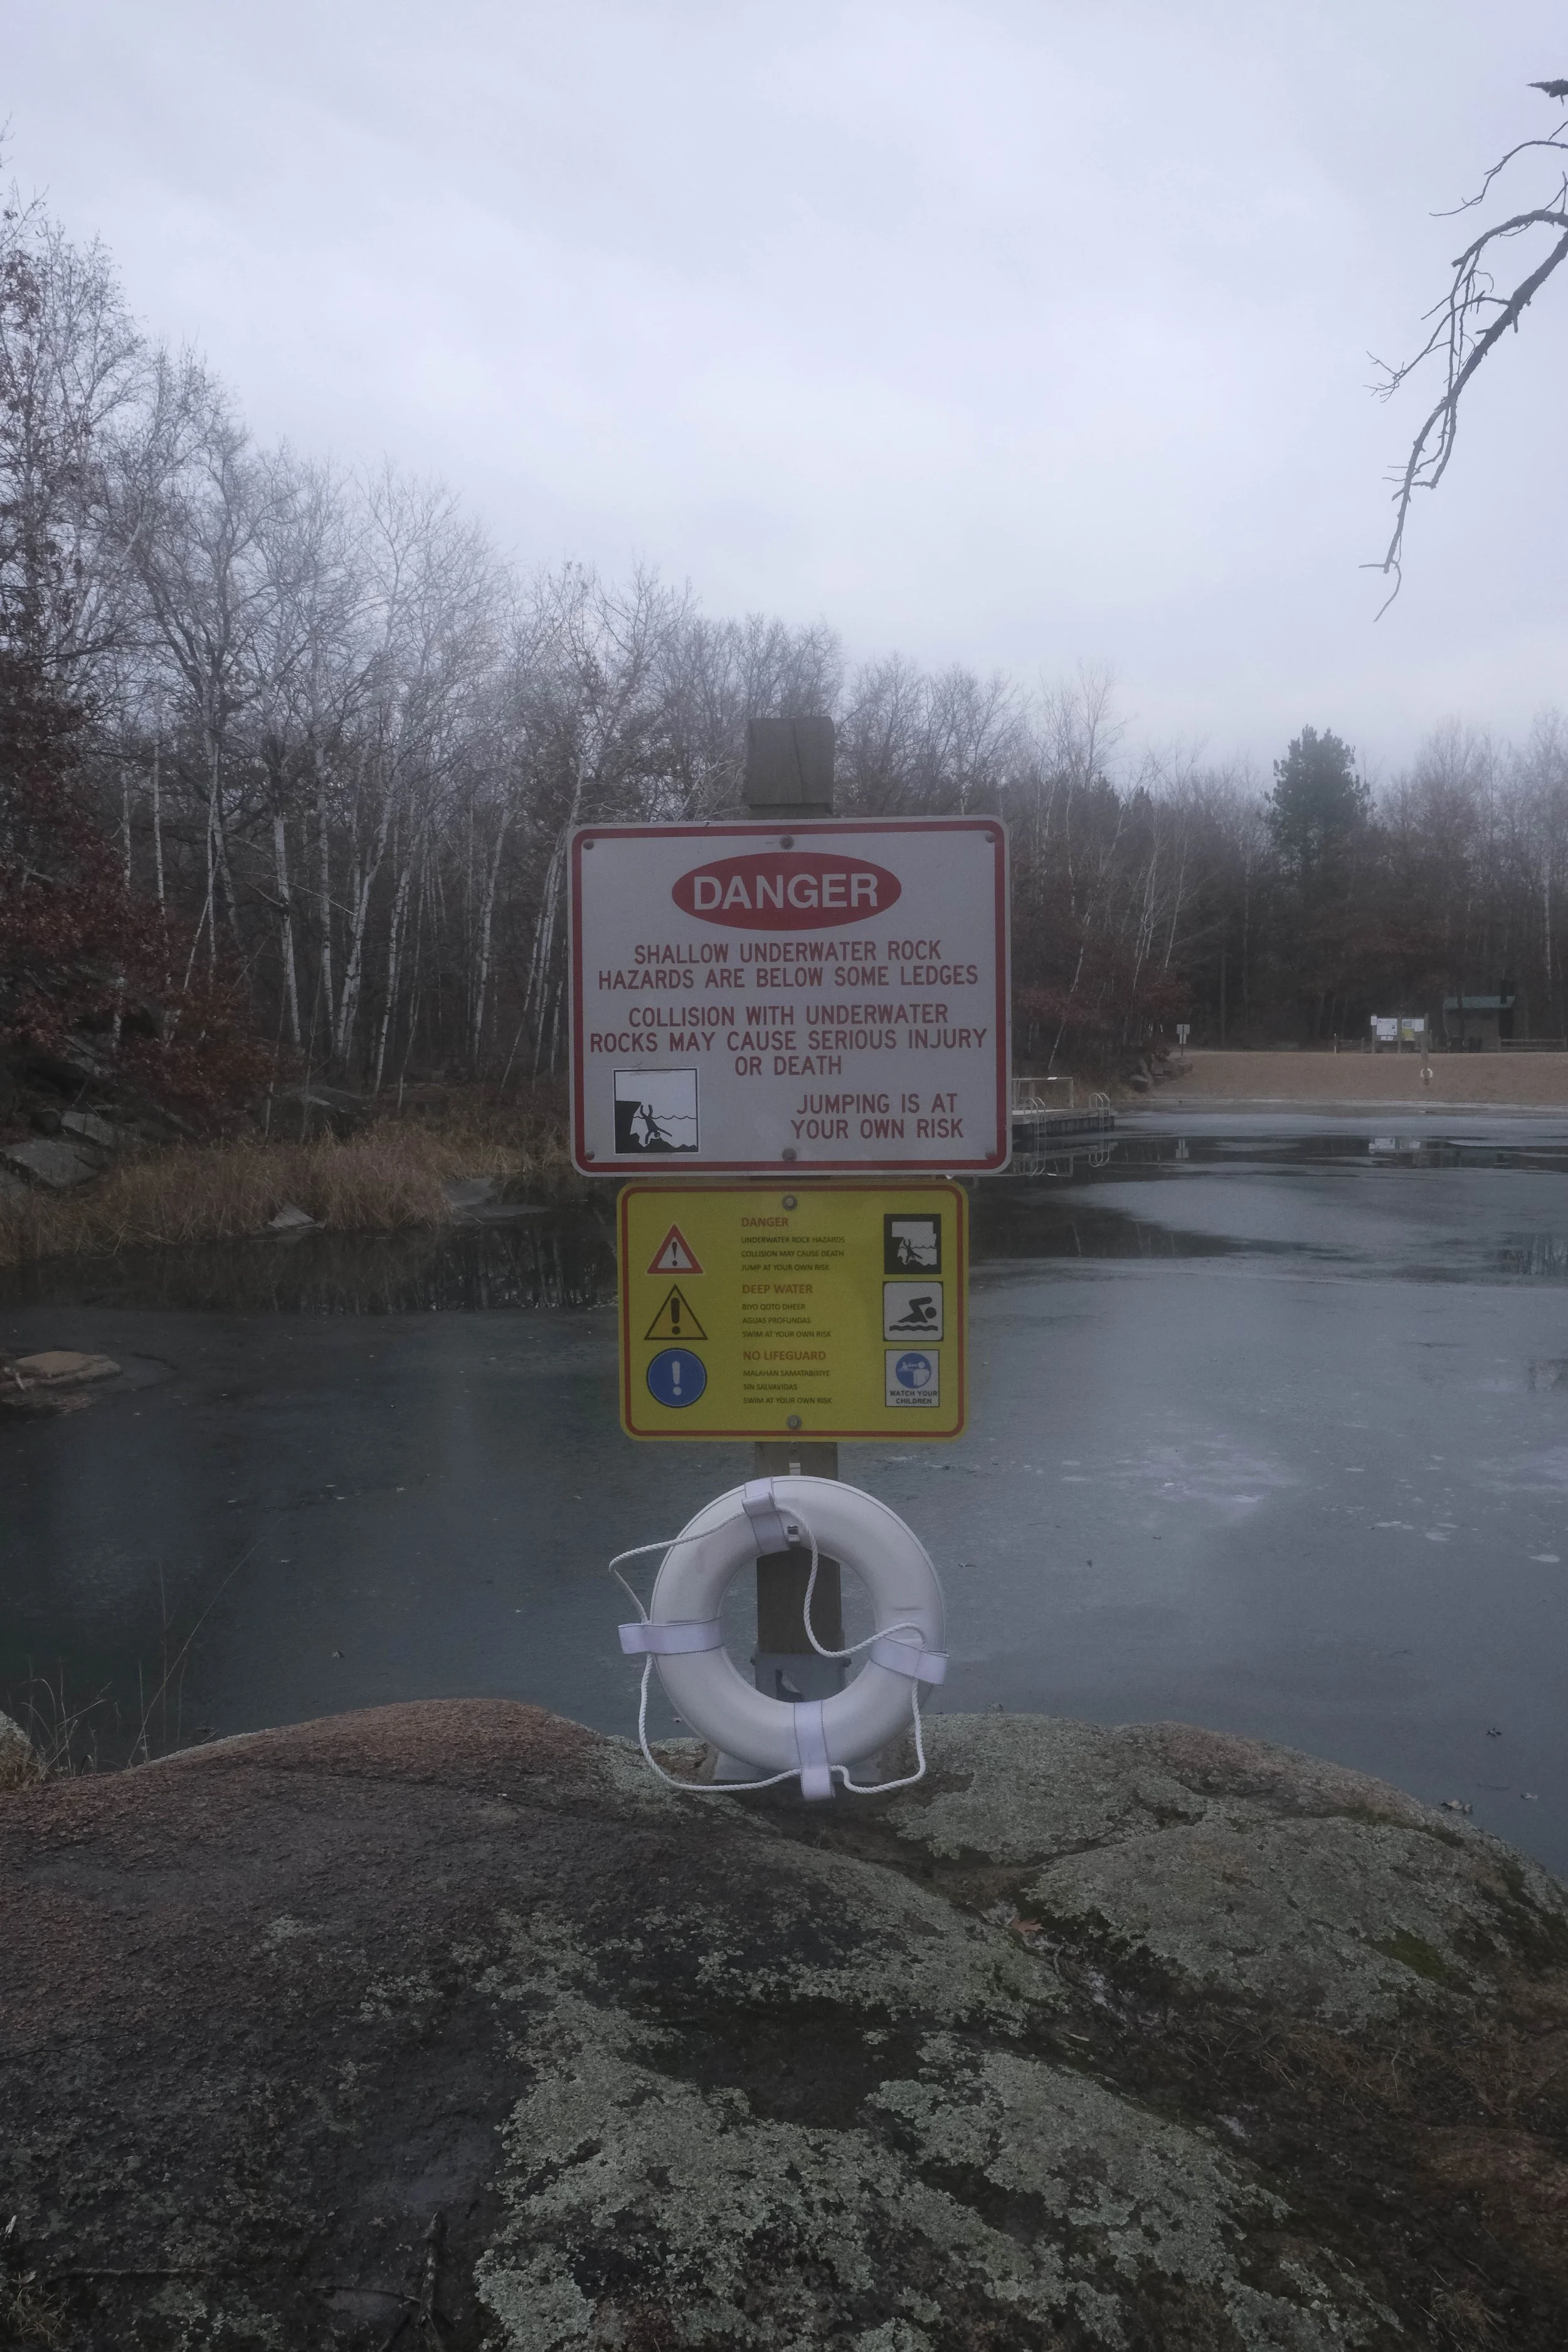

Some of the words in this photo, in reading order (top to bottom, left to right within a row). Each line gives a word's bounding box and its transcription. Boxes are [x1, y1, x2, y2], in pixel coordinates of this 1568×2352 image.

[694, 873, 879, 910] DANGER
[635, 943, 729, 965] SHALLOW
[740, 941, 877, 963] UNDERWATER
[888, 940, 941, 960] ROCK
[598, 969, 694, 990] HAZARDS
[705, 968, 745, 988] ARE
[756, 967, 824, 988] BELOW
[835, 966, 889, 987] SOME
[901, 965, 978, 985] LEDGES
[628, 1006, 734, 1027] COLLISION
[746, 1005, 794, 1025] WITH
[807, 1004, 948, 1025] UNDERWATER
[591, 1032, 658, 1053] ROCKS
[669, 1031, 716, 1051] MAY
[727, 1030, 797, 1051] CAUSE
[808, 1029, 897, 1050] SERIOUS
[909, 1028, 987, 1049] INJURY
[734, 1056, 762, 1076] OR
[774, 1056, 842, 1076] DEATH
[796, 1094, 889, 1115] JUMPING
[901, 1093, 920, 1114] IS
[931, 1093, 958, 1113] AT
[791, 1120, 849, 1139] YOUR
[861, 1119, 904, 1139] OWN
[916, 1118, 964, 1138] RISK
[741, 1217, 788, 1227] DANGER
[742, 1284, 771, 1294] DEEP
[773, 1284, 813, 1294] WATER
[743, 1350, 761, 1360] NO
[764, 1350, 826, 1360] LIFEGUARD
